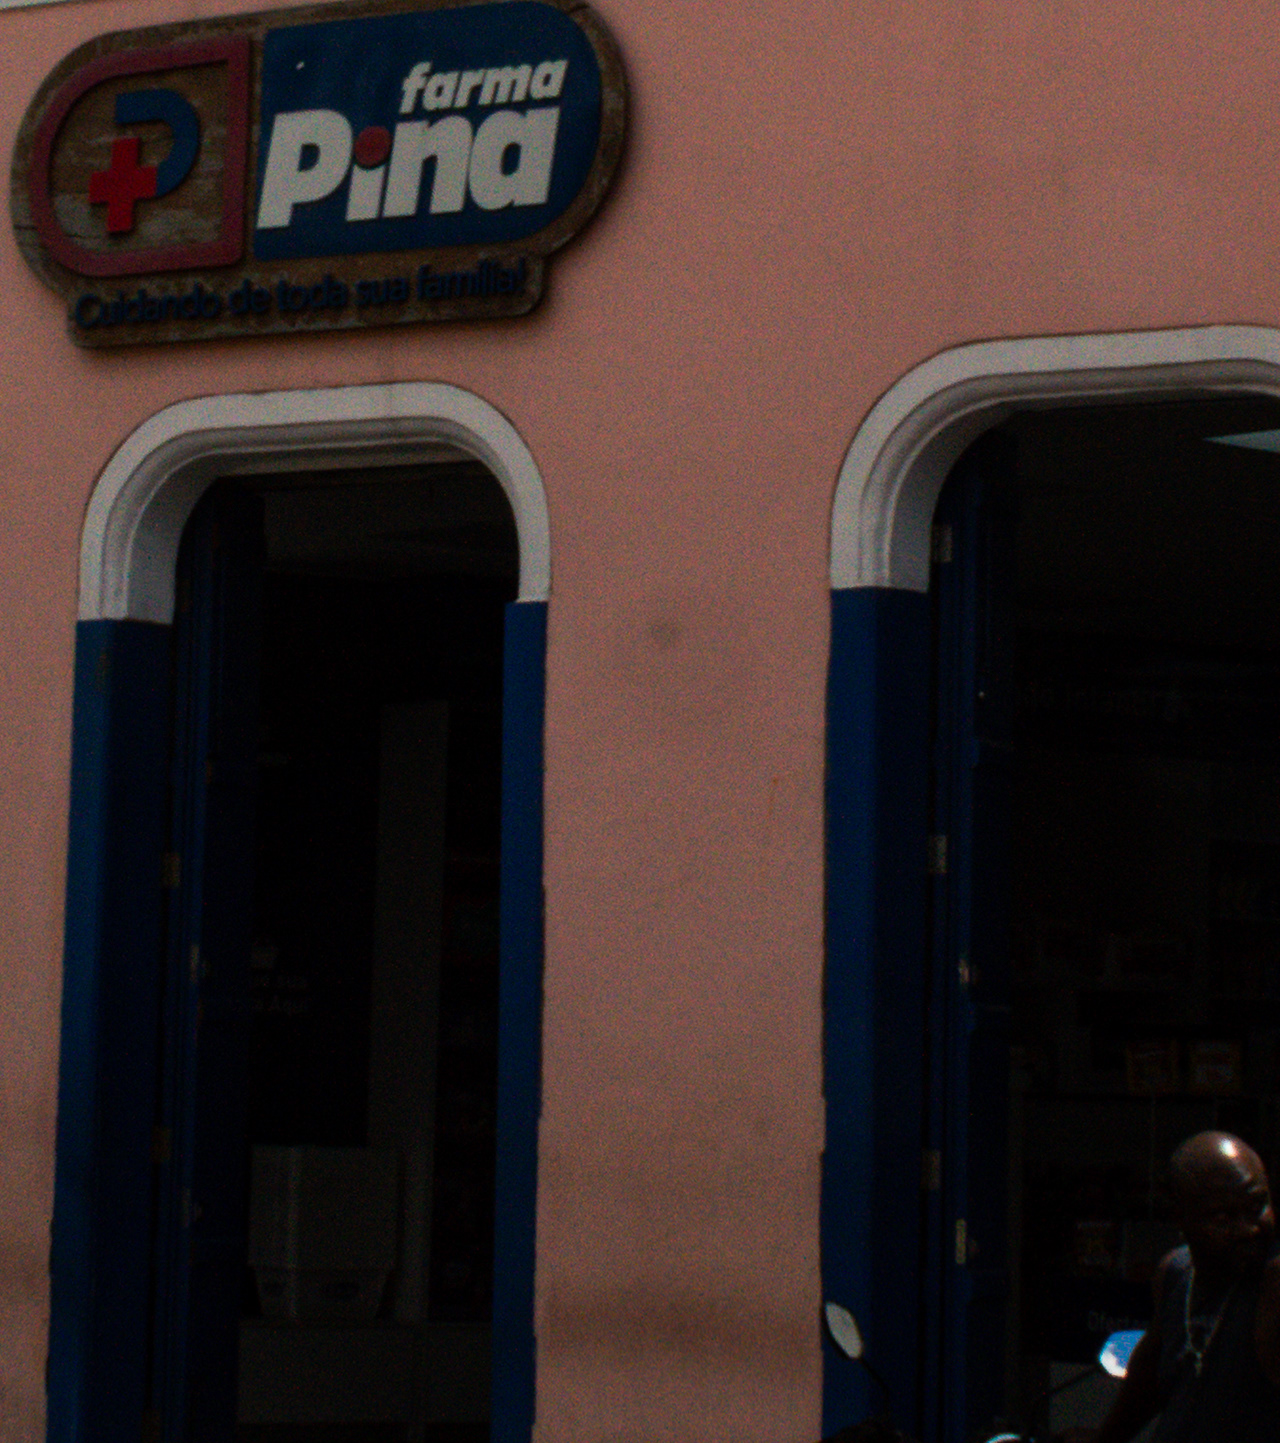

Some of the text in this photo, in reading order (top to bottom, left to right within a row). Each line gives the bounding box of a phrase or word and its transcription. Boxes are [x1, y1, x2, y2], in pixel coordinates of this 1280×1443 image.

[399, 58, 569, 115] farma
[255, 105, 562, 230] Pina
[74, 280, 221, 331] Cuidando
[230, 277, 273, 317] de
[277, 273, 351, 315] toda
[356, 279, 412, 310] sua
